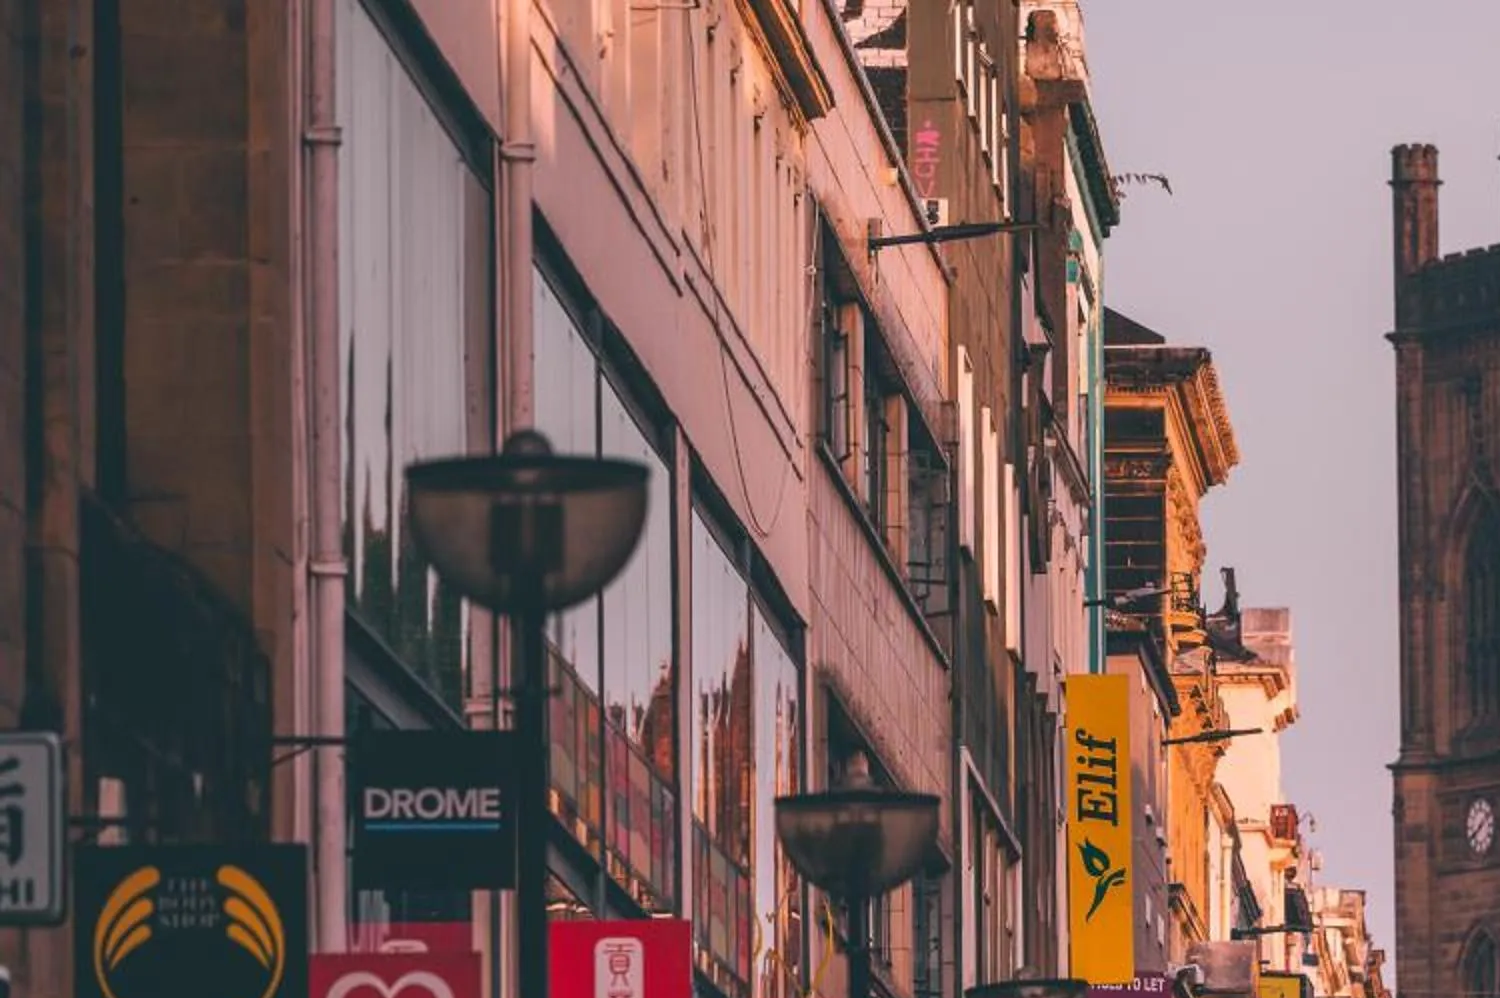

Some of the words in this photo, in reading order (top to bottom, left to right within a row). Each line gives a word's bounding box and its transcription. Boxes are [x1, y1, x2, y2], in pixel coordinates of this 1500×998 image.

[1076, 728, 1118, 827] Elif
[364, 787, 501, 819] DROME
[1144, 979, 1166, 992] LET
